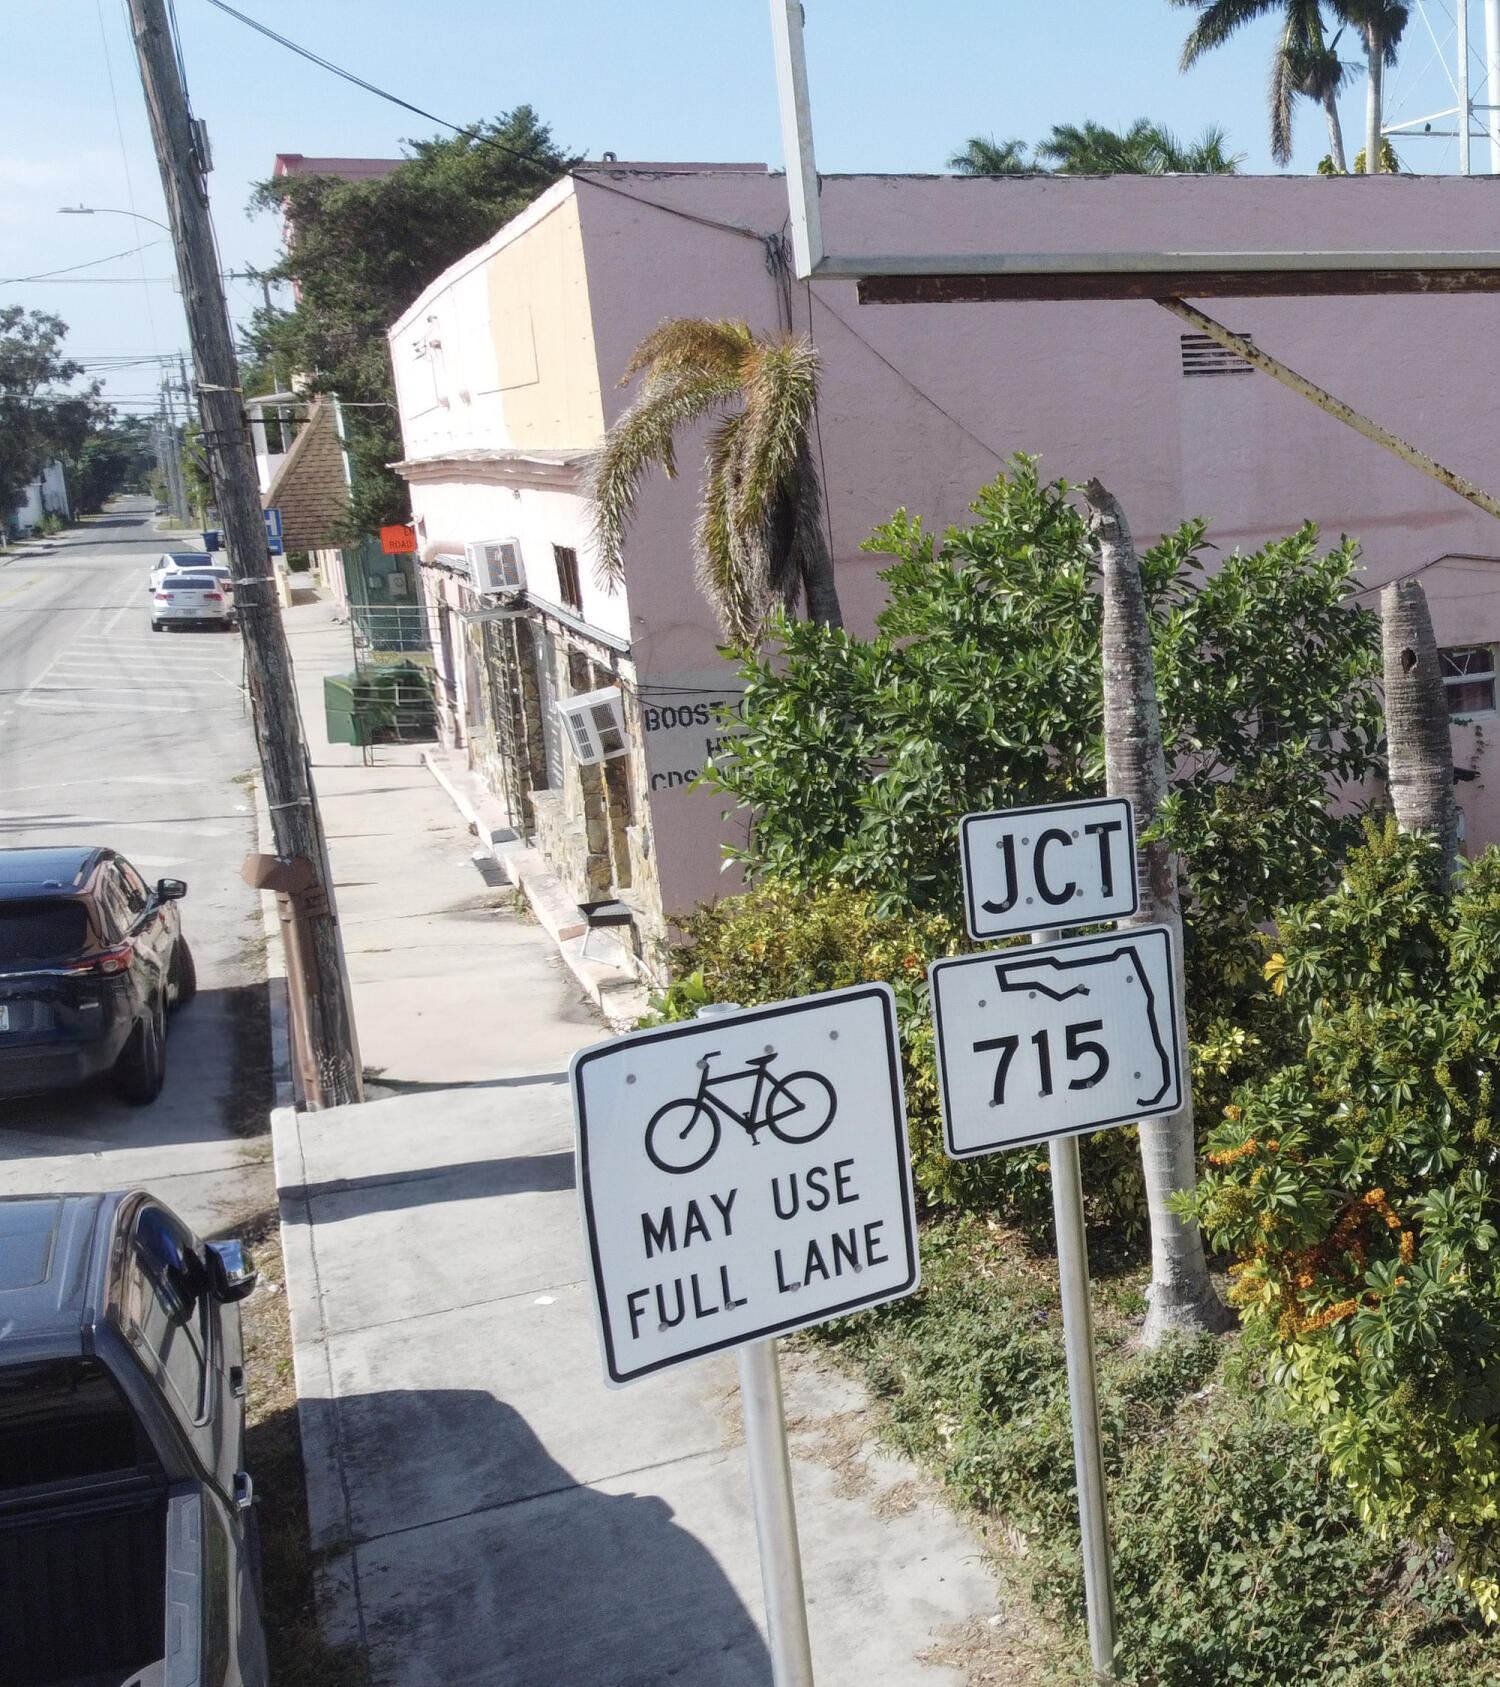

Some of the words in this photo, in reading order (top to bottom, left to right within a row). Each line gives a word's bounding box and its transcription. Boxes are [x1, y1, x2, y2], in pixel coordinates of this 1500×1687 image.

[645, 701, 724, 732] BOOST
[981, 820, 1122, 915] JCT
[973, 1020, 1111, 1106] 715
[641, 1188, 738, 1258] MAY
[771, 1159, 860, 1220] USE
[627, 1265, 748, 1339] FULL
[774, 1219, 889, 1294] LANE
